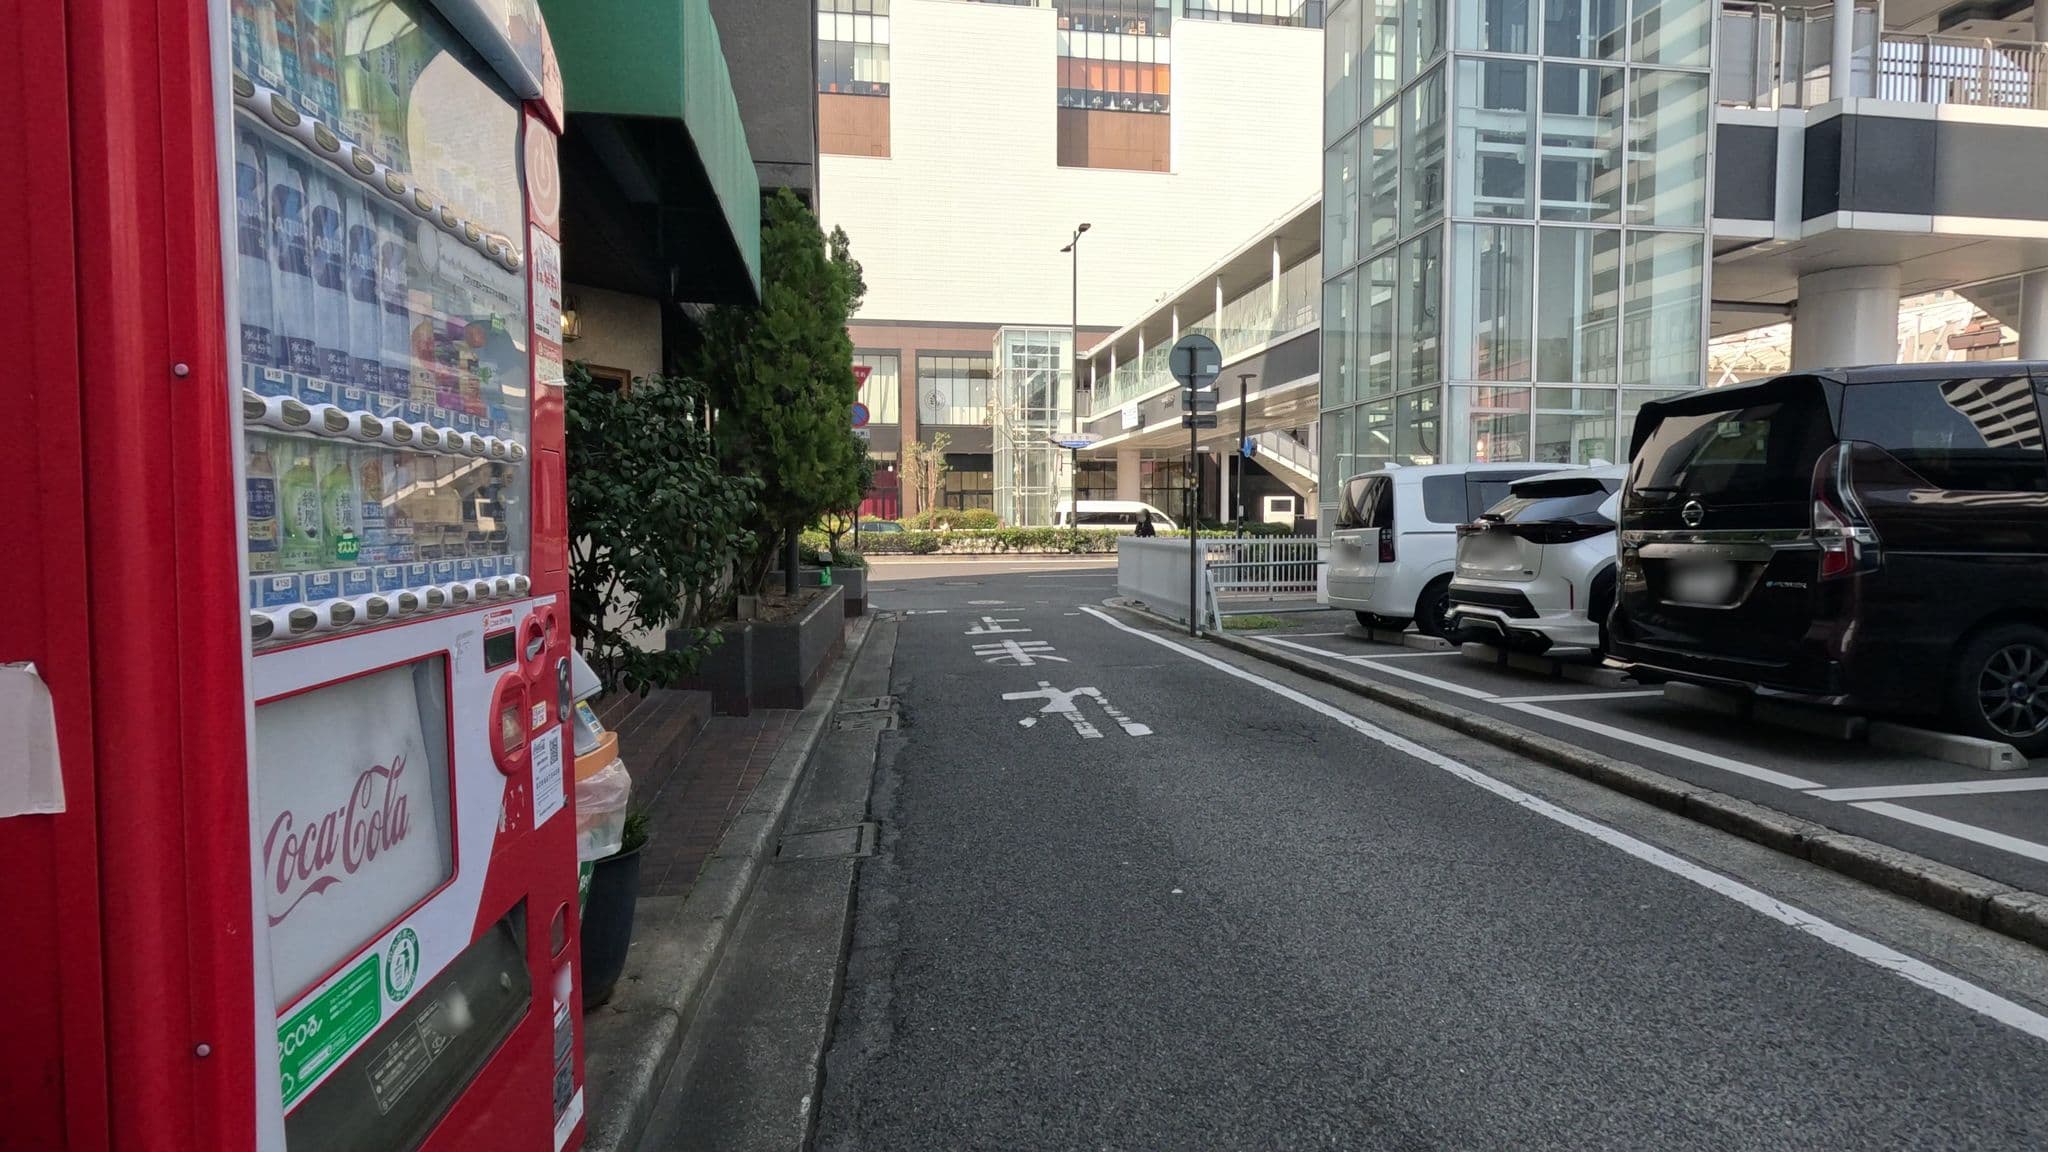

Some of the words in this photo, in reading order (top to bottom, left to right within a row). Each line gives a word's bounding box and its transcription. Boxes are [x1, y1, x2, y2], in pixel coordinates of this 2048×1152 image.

[963, 616, 1154, 739] 止まれ
[263, 755, 410, 925] Coca-Cola
